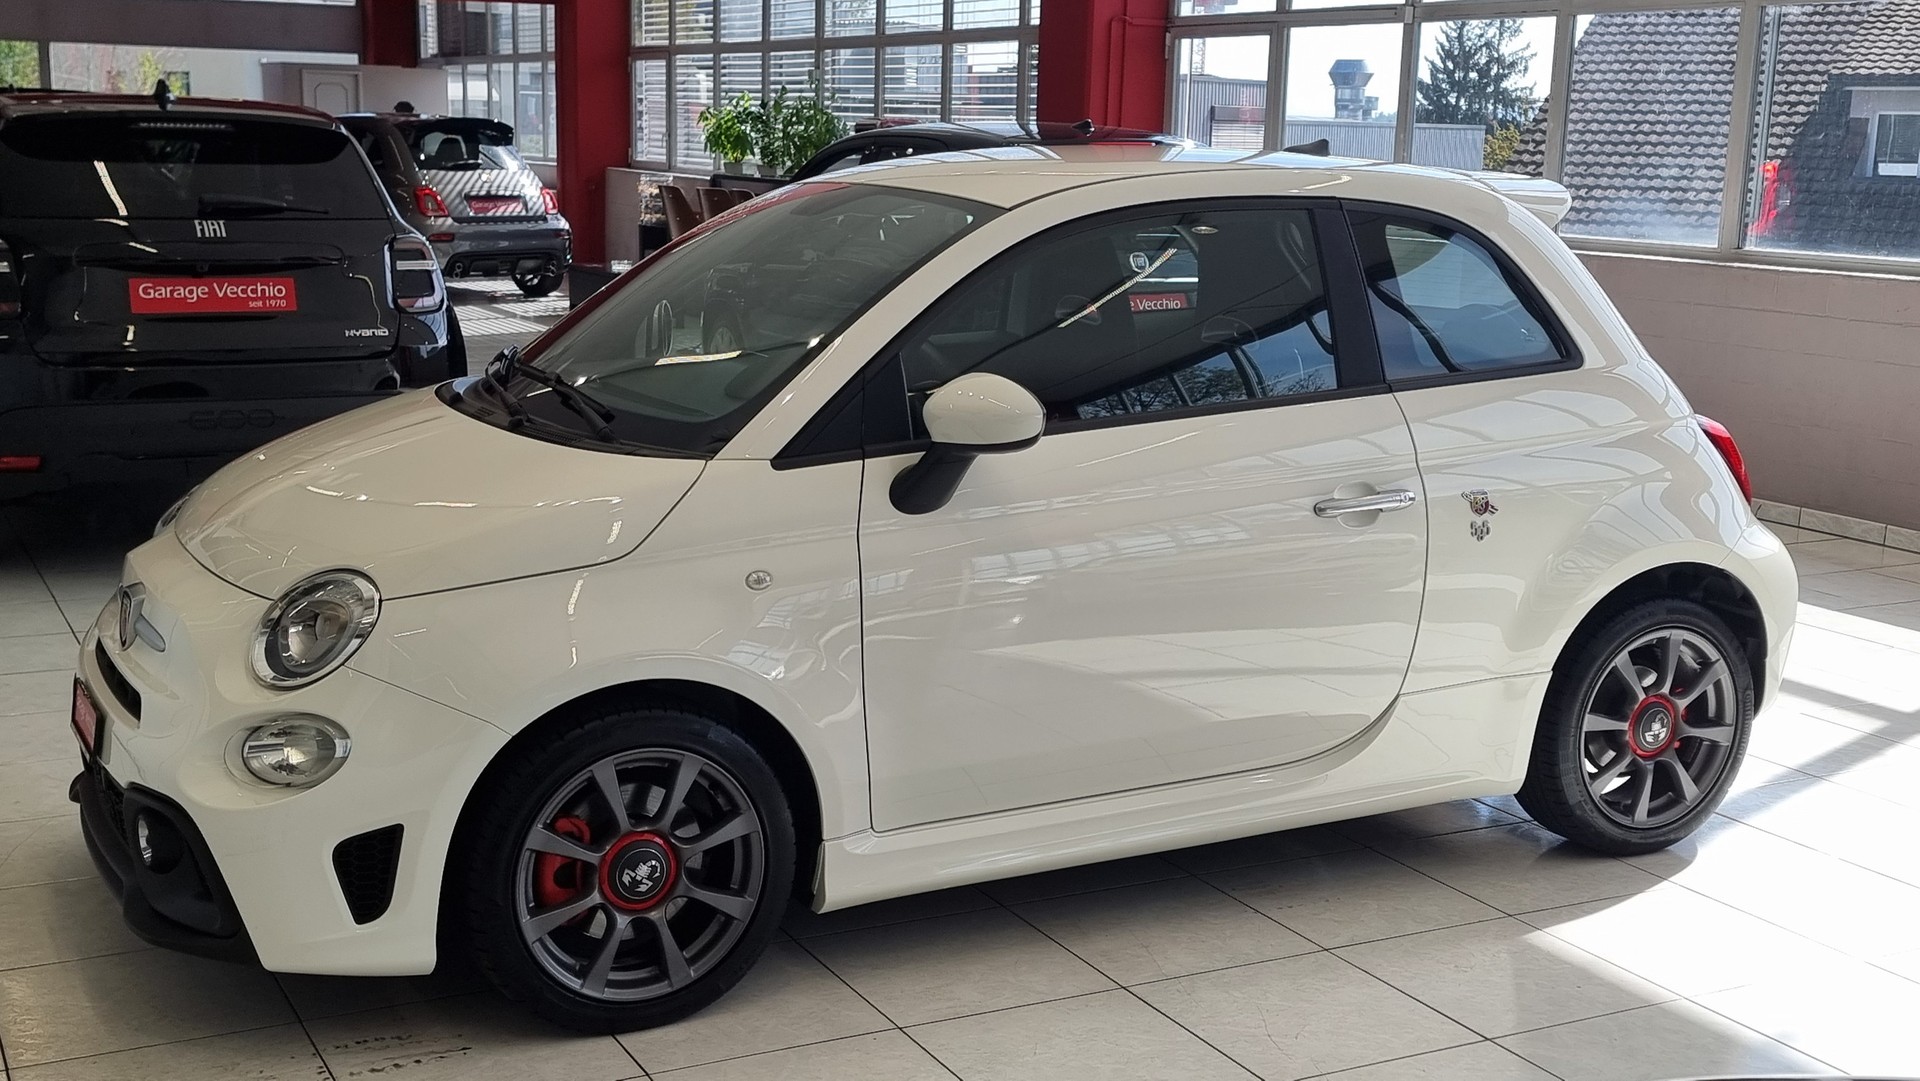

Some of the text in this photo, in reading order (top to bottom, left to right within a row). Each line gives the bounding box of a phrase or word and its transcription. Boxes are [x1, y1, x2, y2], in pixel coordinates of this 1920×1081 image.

[195, 220, 227, 238] FIAT
[139, 282, 286, 302] Garage Vecchio
[248, 299, 287, 308] seit 1970
[1137, 298, 1181, 310] Vecchio
[345, 328, 389, 337] HYBRID
